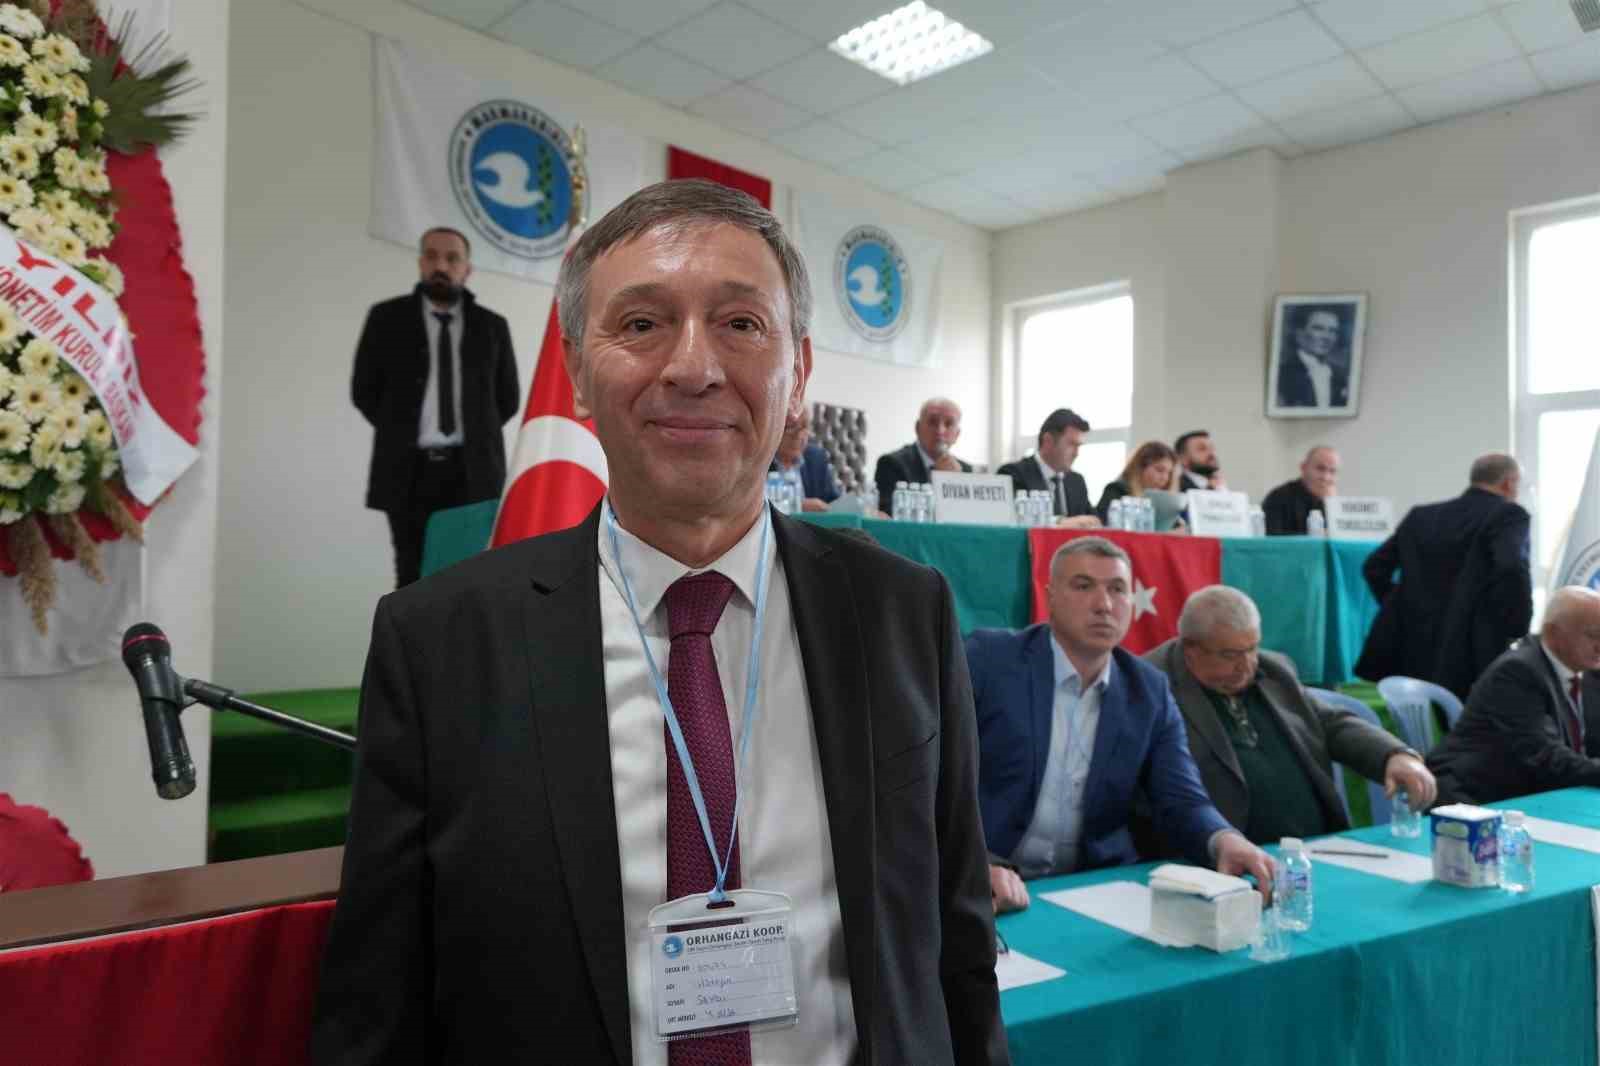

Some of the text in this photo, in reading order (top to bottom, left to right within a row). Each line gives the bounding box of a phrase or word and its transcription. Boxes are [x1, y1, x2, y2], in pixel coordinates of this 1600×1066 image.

[0, 264, 63, 335] ÖNETİM
[686, 930, 750, 946] ORHANGAZİ
[753, 925, 784, 938] KOOP.
